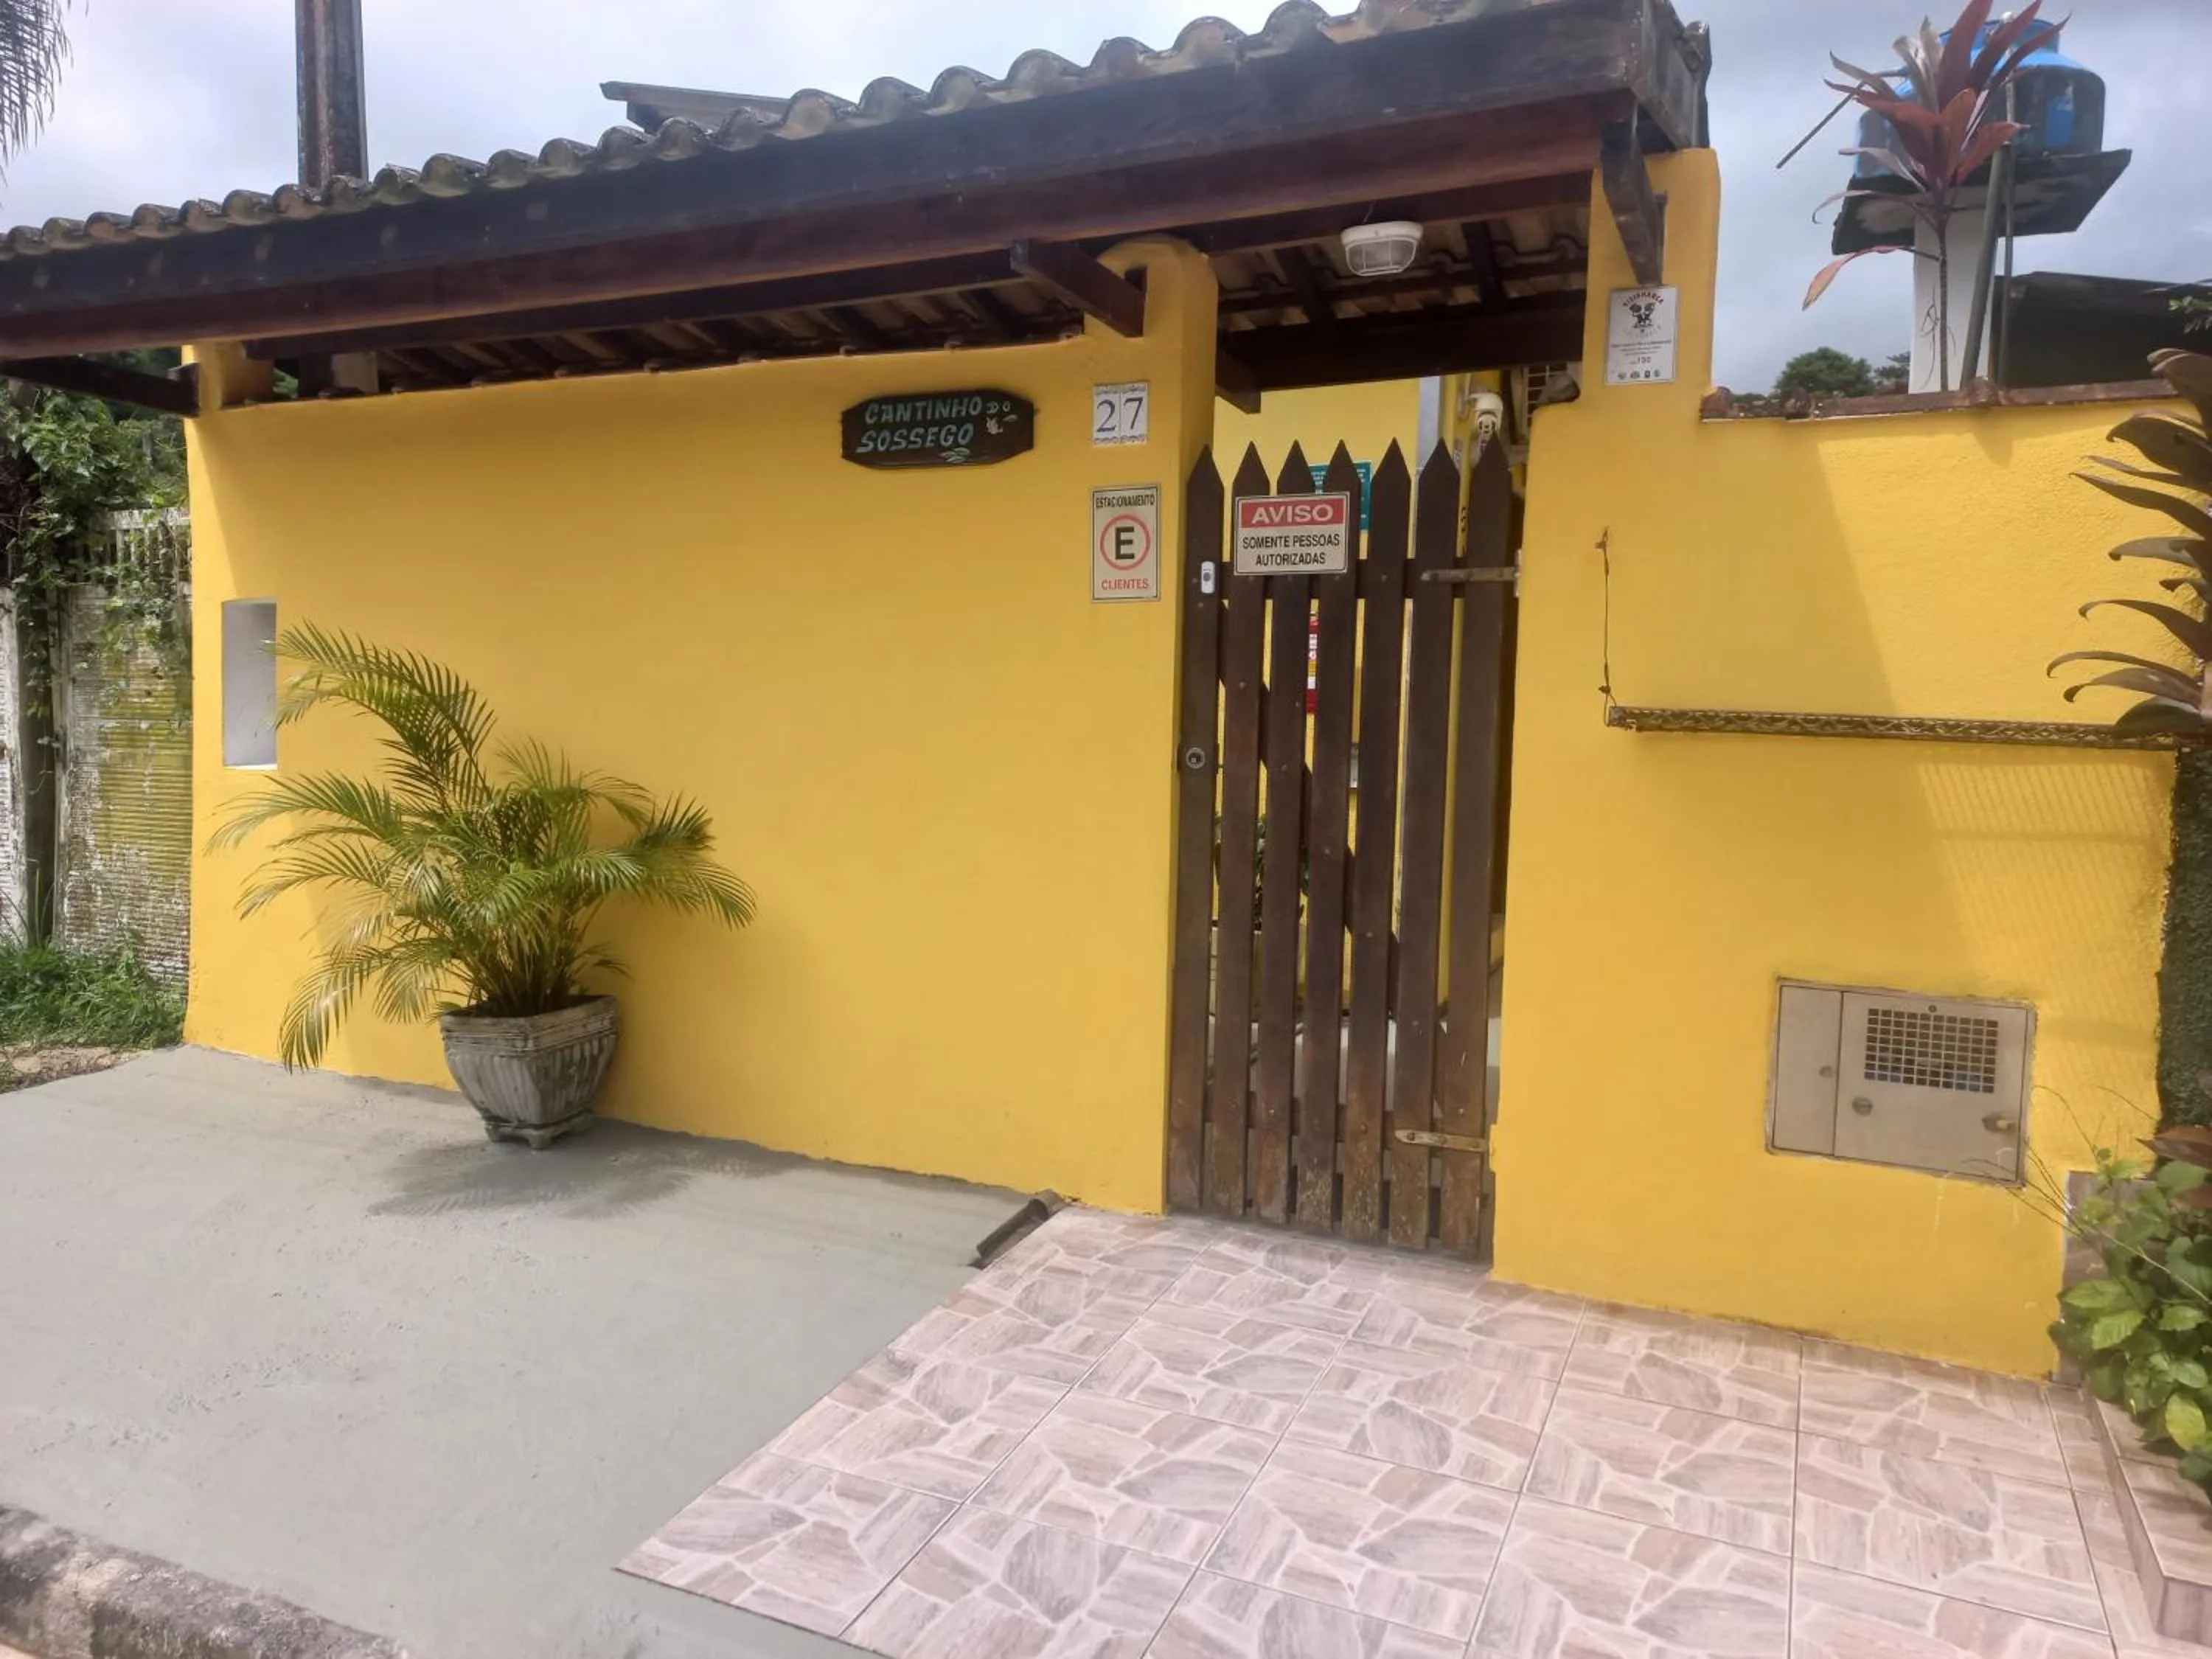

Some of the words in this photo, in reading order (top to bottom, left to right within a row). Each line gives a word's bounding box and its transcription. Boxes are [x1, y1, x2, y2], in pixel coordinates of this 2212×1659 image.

[865, 397, 982, 424] CANTINHO
[1096, 397, 1144, 432] 27
[856, 423, 974, 453] SOSSEGO
[1096, 494, 1155, 508] ESTACIONAMENTO
[1251, 504, 1333, 524] AVISO
[1115, 526, 1135, 560] E
[1242, 536, 1290, 549] SOMENTE
[1293, 533, 1340, 548] PESSOAS
[1256, 552, 1326, 566] AUTORIZADAS
[1101, 578, 1149, 590] CLIENTES
